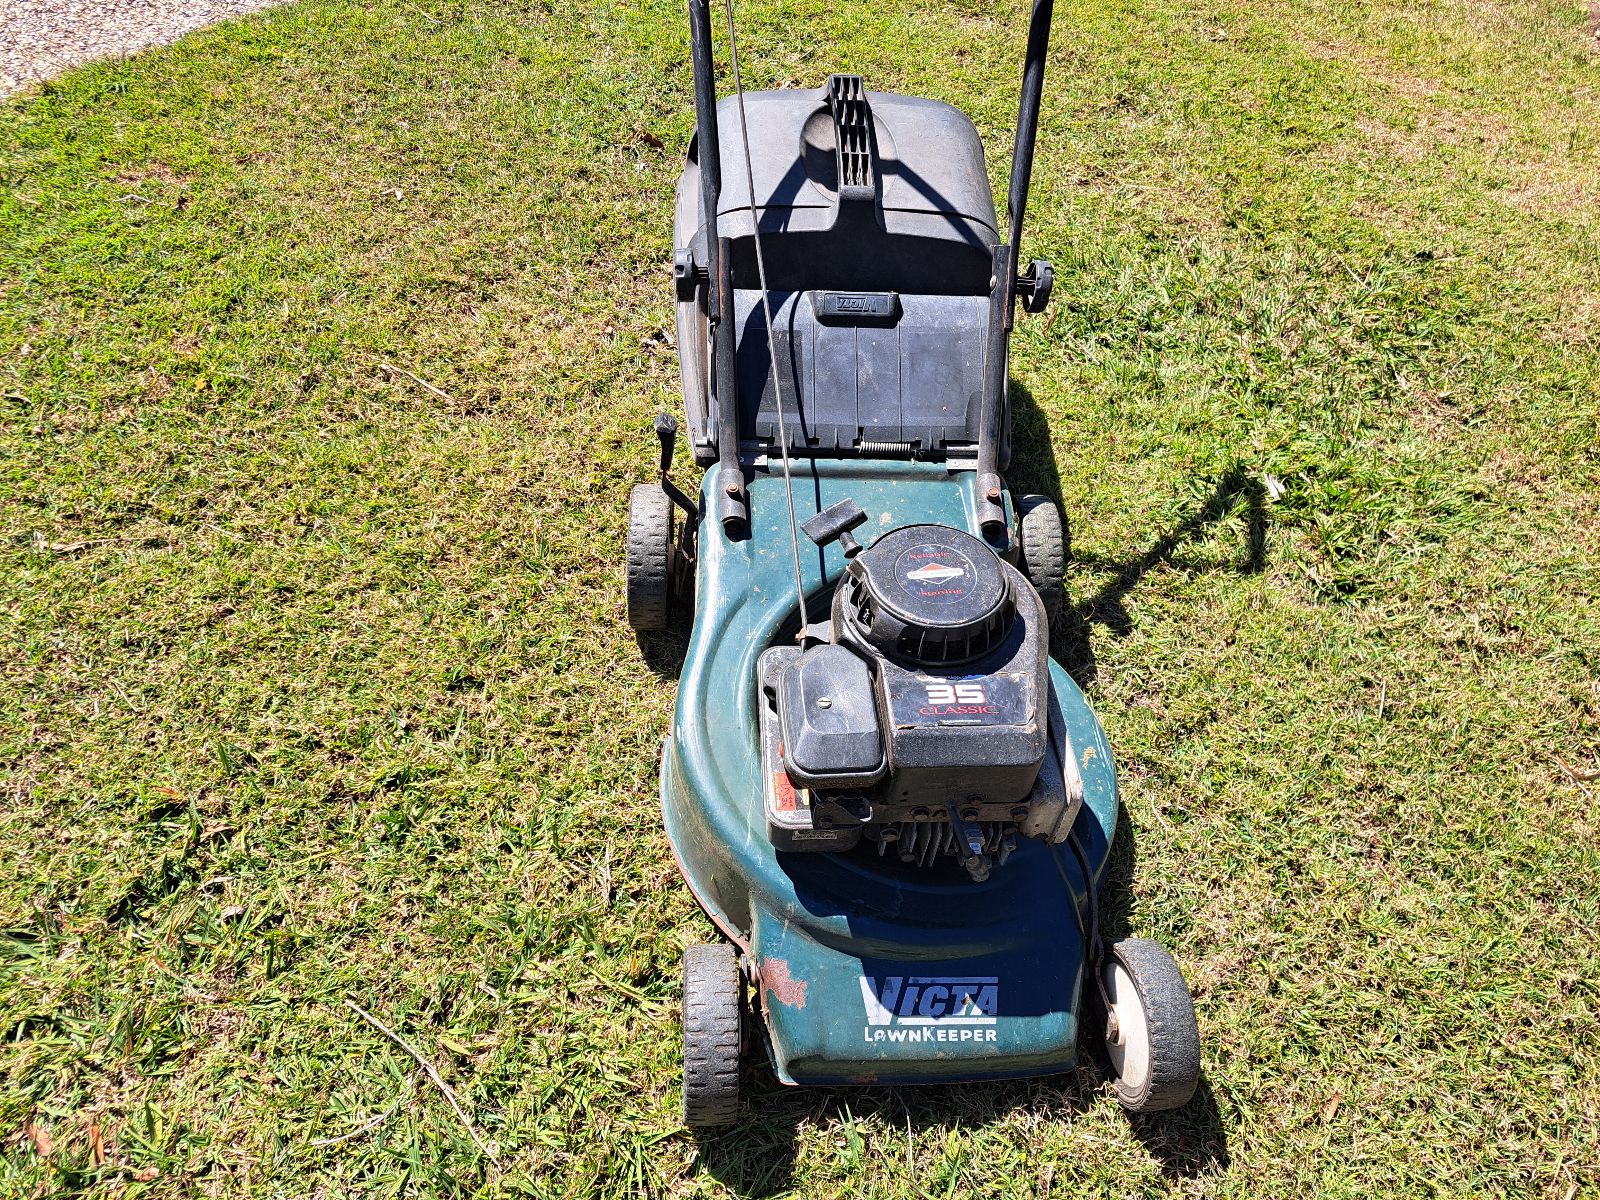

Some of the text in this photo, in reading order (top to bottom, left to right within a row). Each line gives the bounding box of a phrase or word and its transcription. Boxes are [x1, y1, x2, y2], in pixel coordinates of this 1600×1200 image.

[926, 684, 986, 704] 35
[920, 705, 999, 717] CLASSIC
[859, 976, 998, 1025] VICTA
[864, 1026, 997, 1042] LAWNKEEPER
